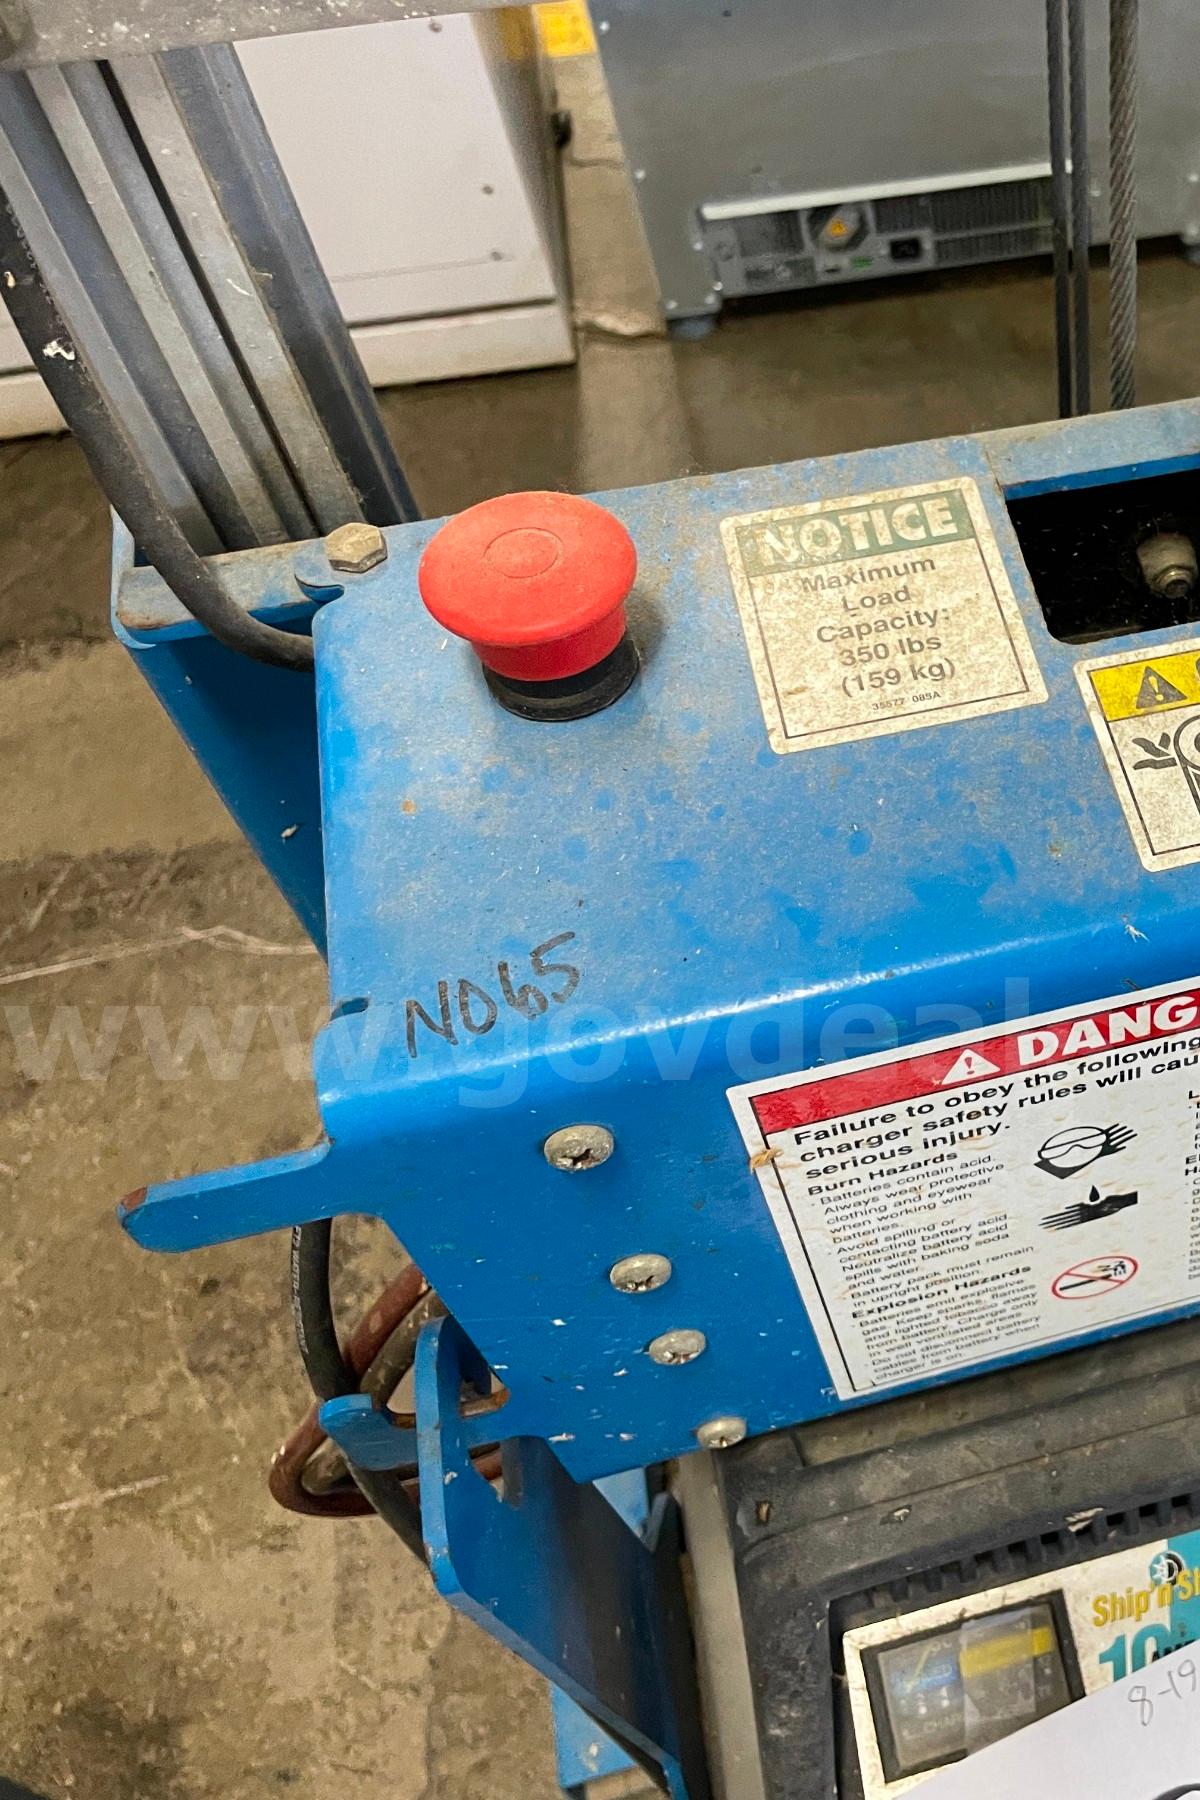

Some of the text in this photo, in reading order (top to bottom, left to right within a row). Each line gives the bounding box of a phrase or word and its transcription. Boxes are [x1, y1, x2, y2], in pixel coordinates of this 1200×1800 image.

[756, 499, 956, 565] NOTICE
[800, 558, 936, 593] Maximum
[841, 584, 911, 612] Load
[816, 608, 949, 644] Capacity:
[839, 636, 942, 667] 350 lbs
[841, 657, 955, 698] (159 kg)
[794, 1113, 896, 1145] Failure
[905, 1103, 935, 1118] to
[944, 1082, 1014, 1108] obey
[1023, 1070, 1068, 1088] the
[800, 1126, 912, 1162] charger
[922, 1102, 1008, 1132] safety
[1018, 1083, 1087, 1108] rules
[1095, 1066, 1141, 1088] will
[806, 1121, 1010, 1179] serious injury.
[807, 1152, 958, 1196] Burn Hazards
[819, 1182, 891, 1205] Batteries
[896, 1165, 954, 1185] contain
[824, 1163, 1004, 1215] Always wear protective
[826, 1176, 991, 1225] clothing and eyewear
[851, 1266, 1031, 1319] Explosion Hazards
[1128, 1659, 1197, 1727] 8-19
